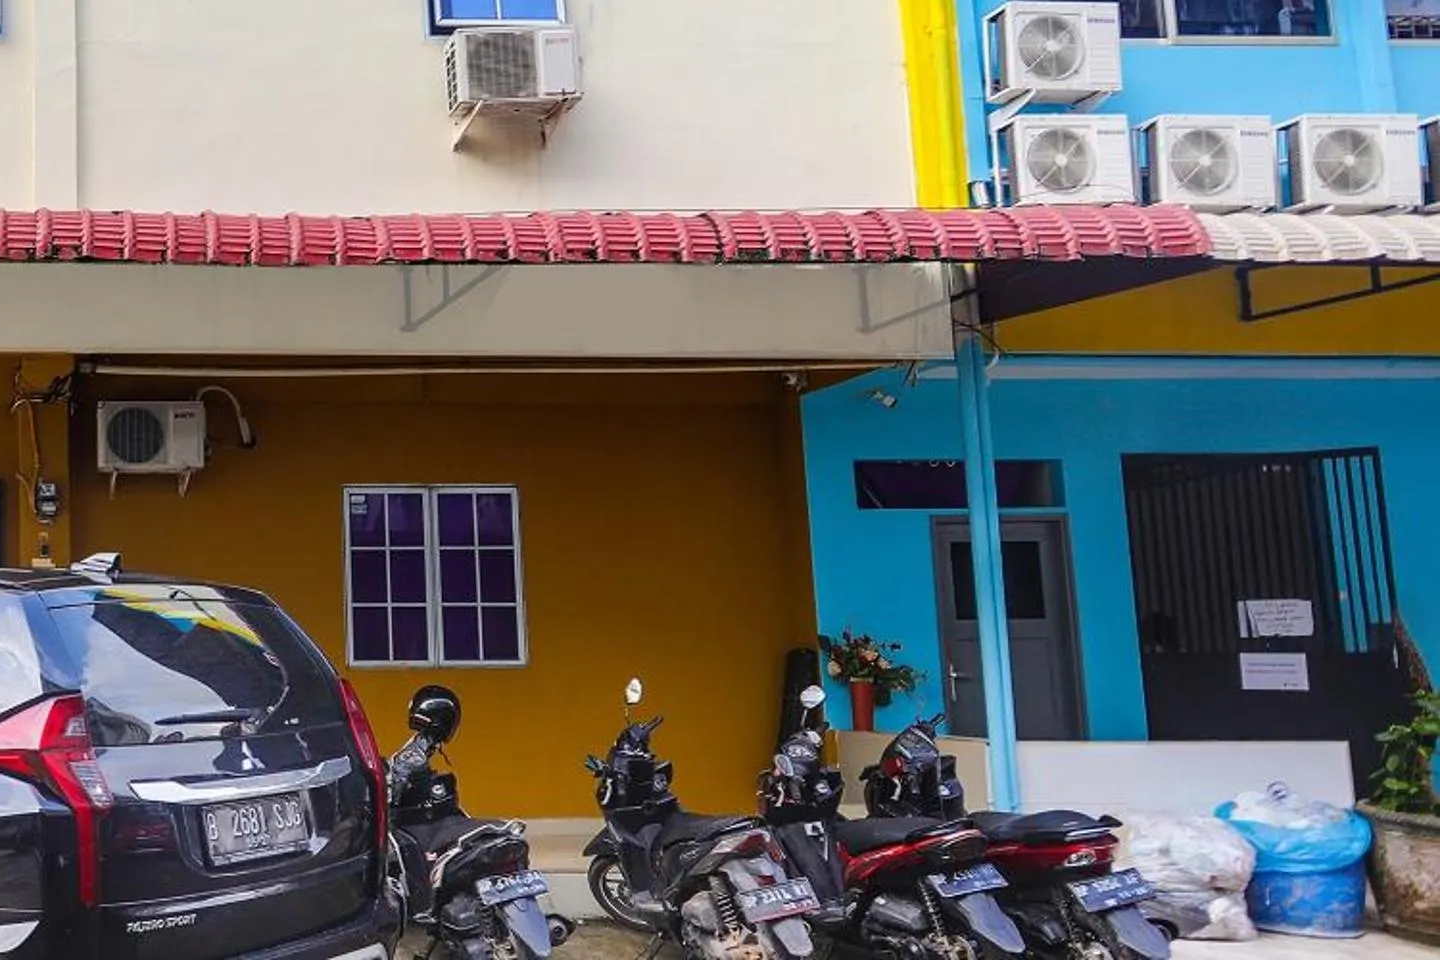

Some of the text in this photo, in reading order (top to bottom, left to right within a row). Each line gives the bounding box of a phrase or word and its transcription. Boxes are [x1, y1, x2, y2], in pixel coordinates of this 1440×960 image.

[206, 812, 219, 841] B
[232, 804, 268, 837] 2681
[164, 913, 197, 929] SPORT
